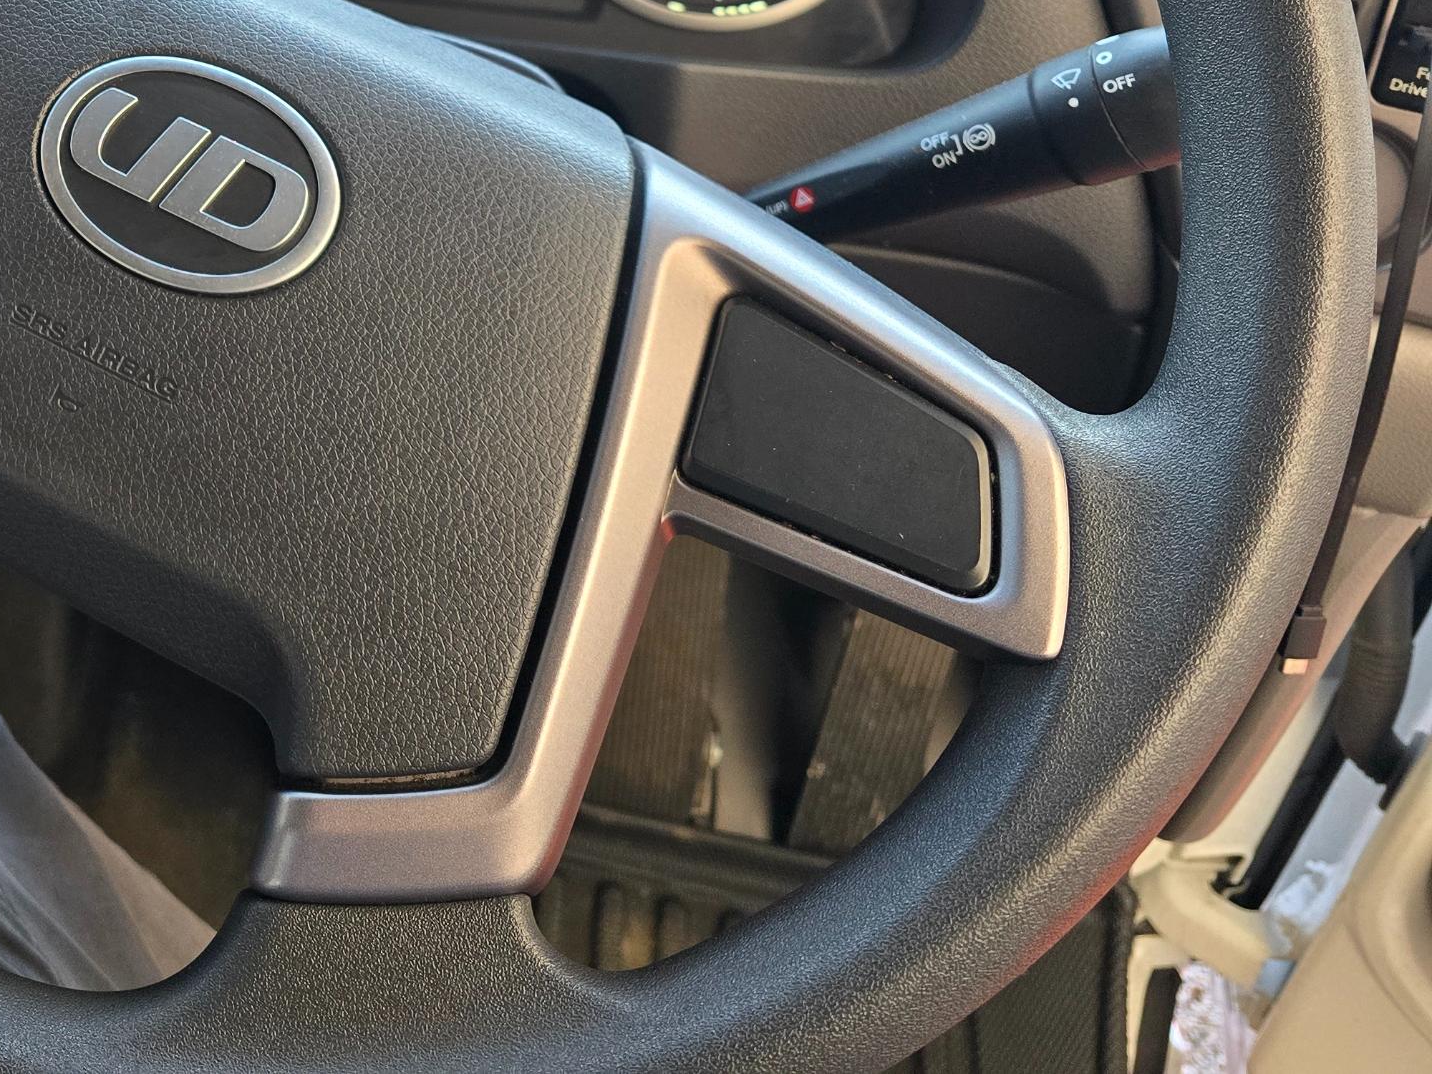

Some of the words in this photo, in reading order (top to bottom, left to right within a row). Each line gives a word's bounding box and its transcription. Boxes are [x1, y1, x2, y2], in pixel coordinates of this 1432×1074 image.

[1102, 73, 1136, 94] OFF
[920, 131, 949, 151] OFF
[70, 87, 309, 252] UD
[932, 150, 958, 169] ON
[8, 305, 65, 344] SRS
[70, 336, 179, 402] AIRBAG
